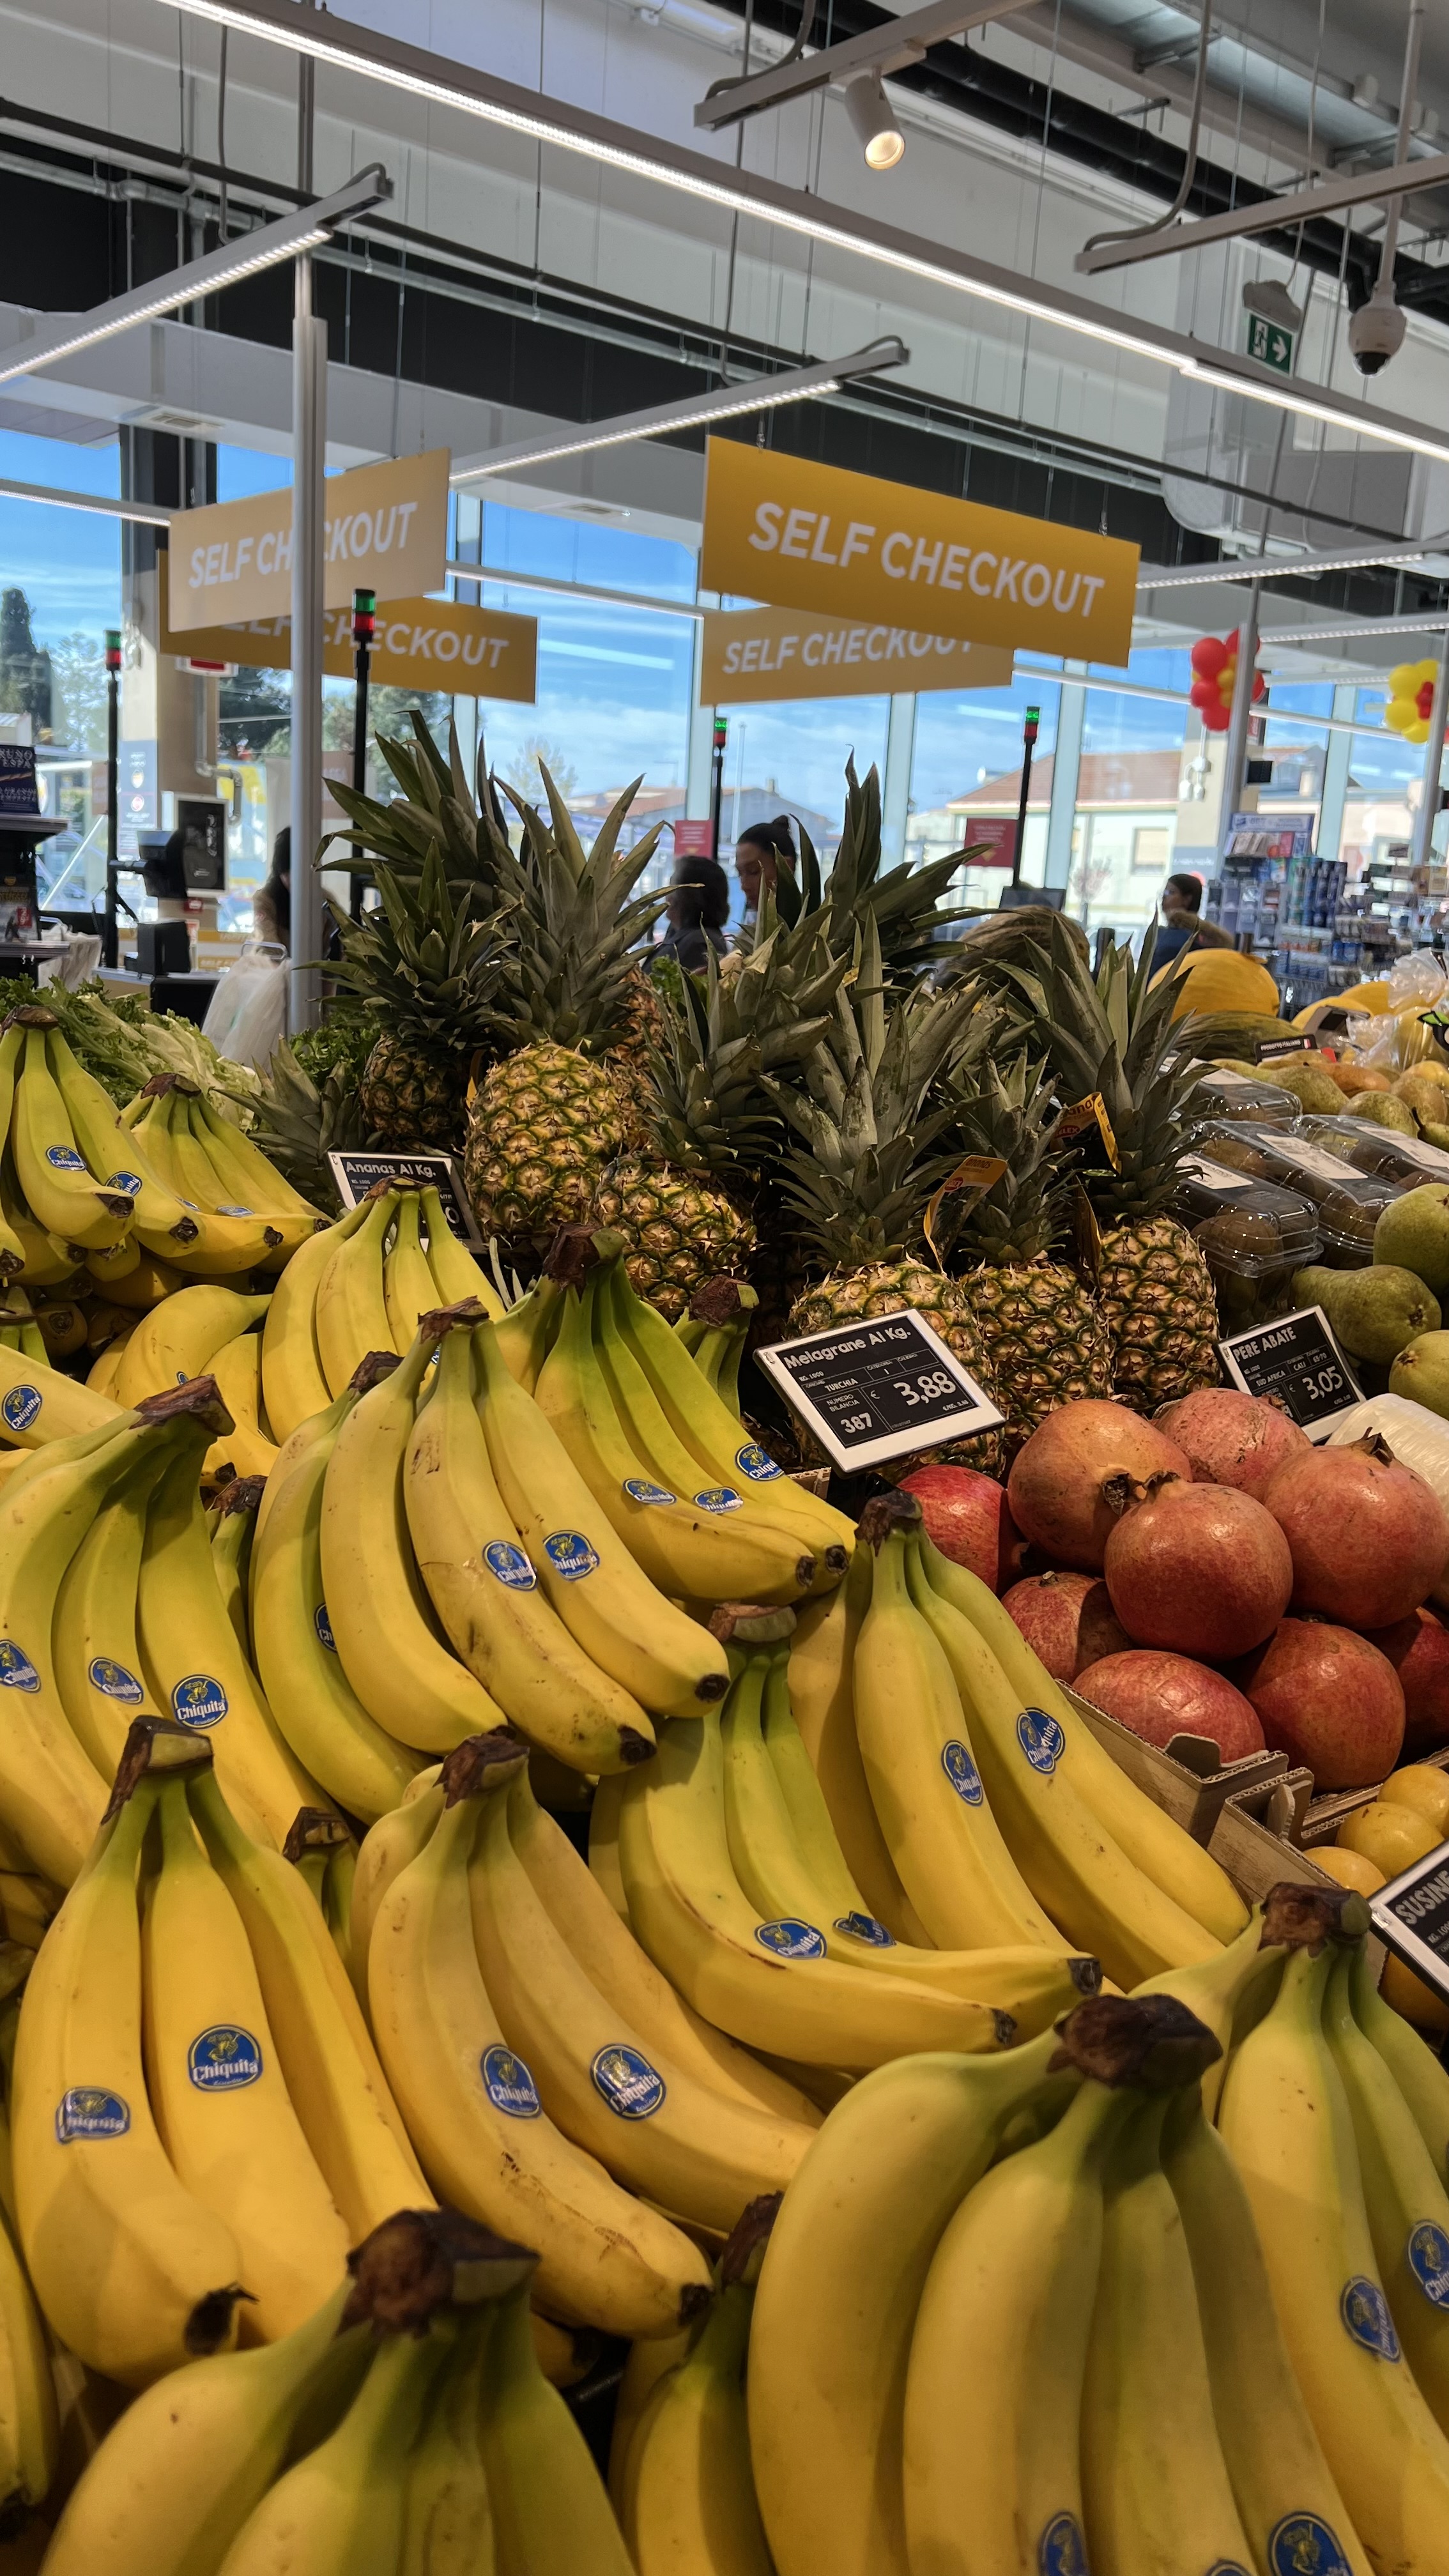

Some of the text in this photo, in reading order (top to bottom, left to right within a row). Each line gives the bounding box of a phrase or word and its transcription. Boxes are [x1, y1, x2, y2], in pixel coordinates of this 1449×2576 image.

[189, 537, 254, 588] SELF
[747, 502, 1105, 617] SELF CHECKOUT
[722, 635, 799, 674] SELF
[1056, 1127, 1078, 1135] ELEX
[346, 1161, 436, 1178] Ananas Al Kg.
[783, 1325, 912, 1369] Melagrane Al Kg.
[1233, 1326, 1297, 1363] PERE ABATE
[824, 1377, 859, 1392] TURCHIA
[1267, 1370, 1286, 1383] AFRICA
[1289, 1365, 1343, 1400] € 3,05
[870, 1371, 956, 1406] € 3,88
[826, 1394, 854, 1406] NUMERO
[829, 1399, 860, 1412] BILANCIA
[11, 1396, 41, 1429] Chiquita
[840, 1413, 873, 1434] 387
[749, 1459, 778, 1479] Chiqui
[177, 1700, 226, 1720] Chiquita
[778, 1931, 820, 1956] Chiquita
[192, 2058, 259, 2082] Chiquita
[490, 2083, 539, 2104] Chiquita
[610, 2073, 661, 2112] Chiquita
[66, 2115, 126, 2131] hiquita
